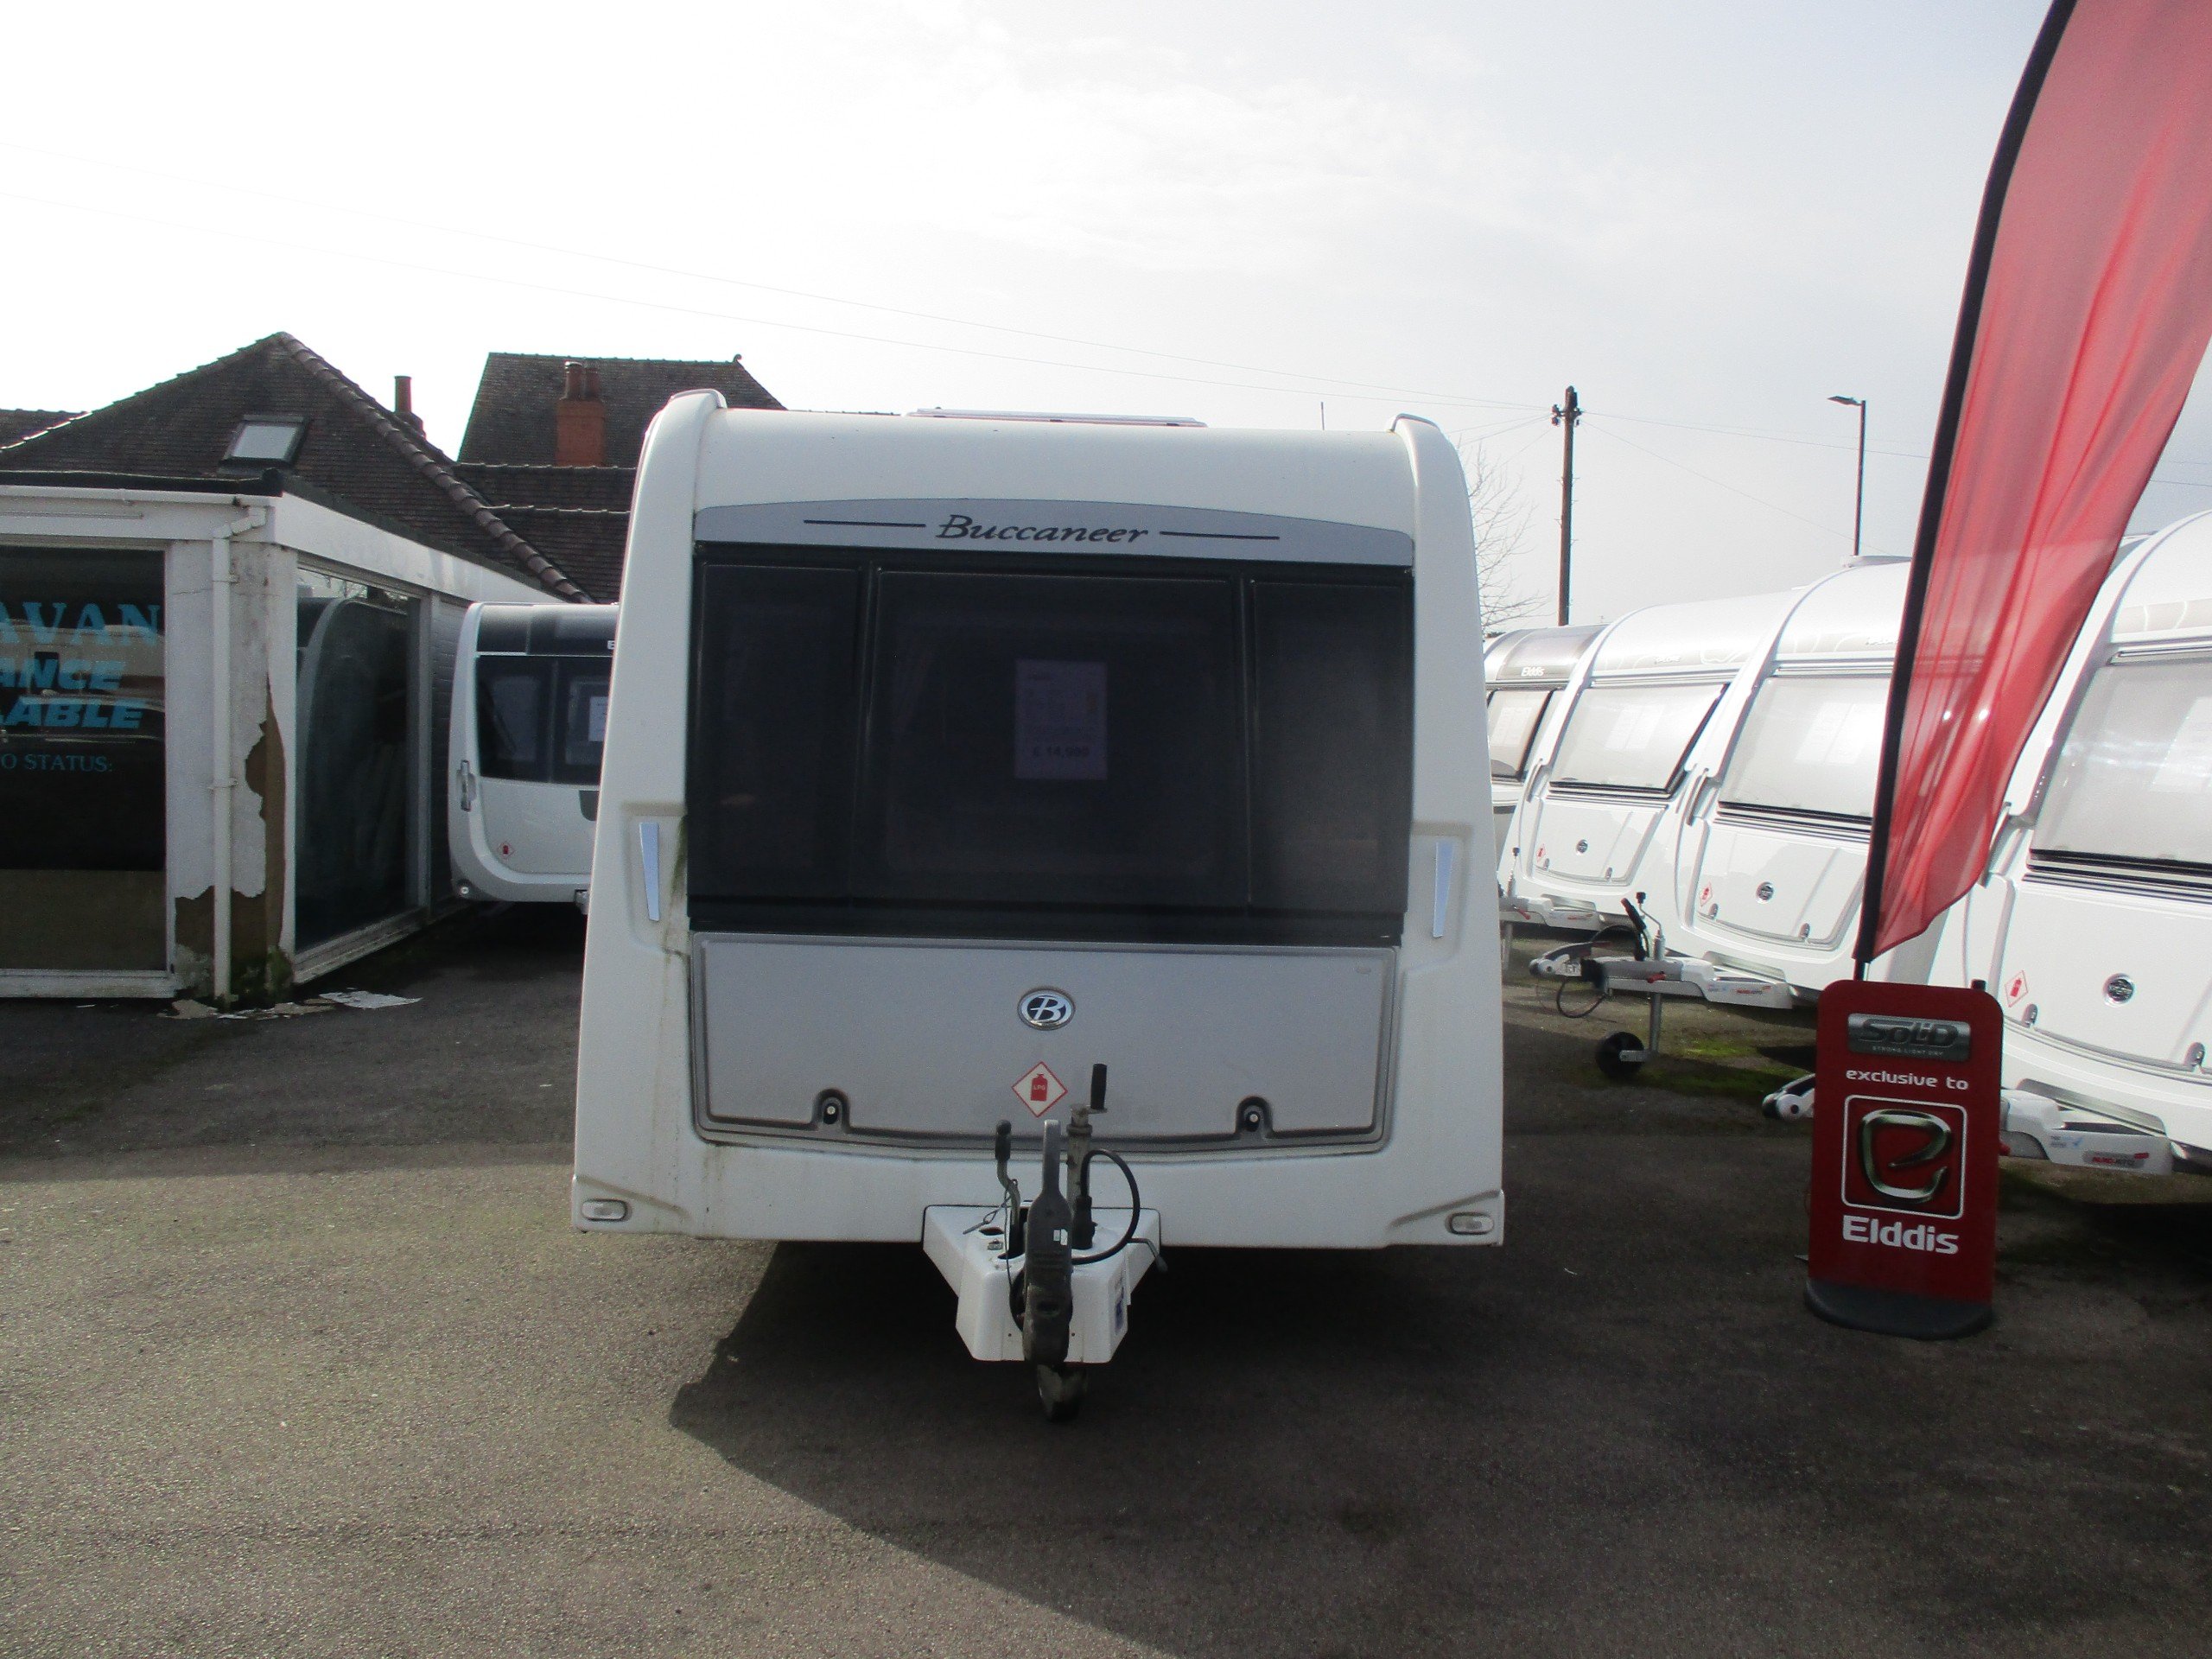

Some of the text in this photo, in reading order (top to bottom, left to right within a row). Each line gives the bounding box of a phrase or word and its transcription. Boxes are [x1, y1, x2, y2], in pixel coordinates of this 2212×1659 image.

[936, 514, 1148, 543] Buccaneer
[0, 695, 145, 728] ABLE
[1846, 1069, 1969, 1090] exclusive to
[1842, 1214, 1960, 1255] Elddis
